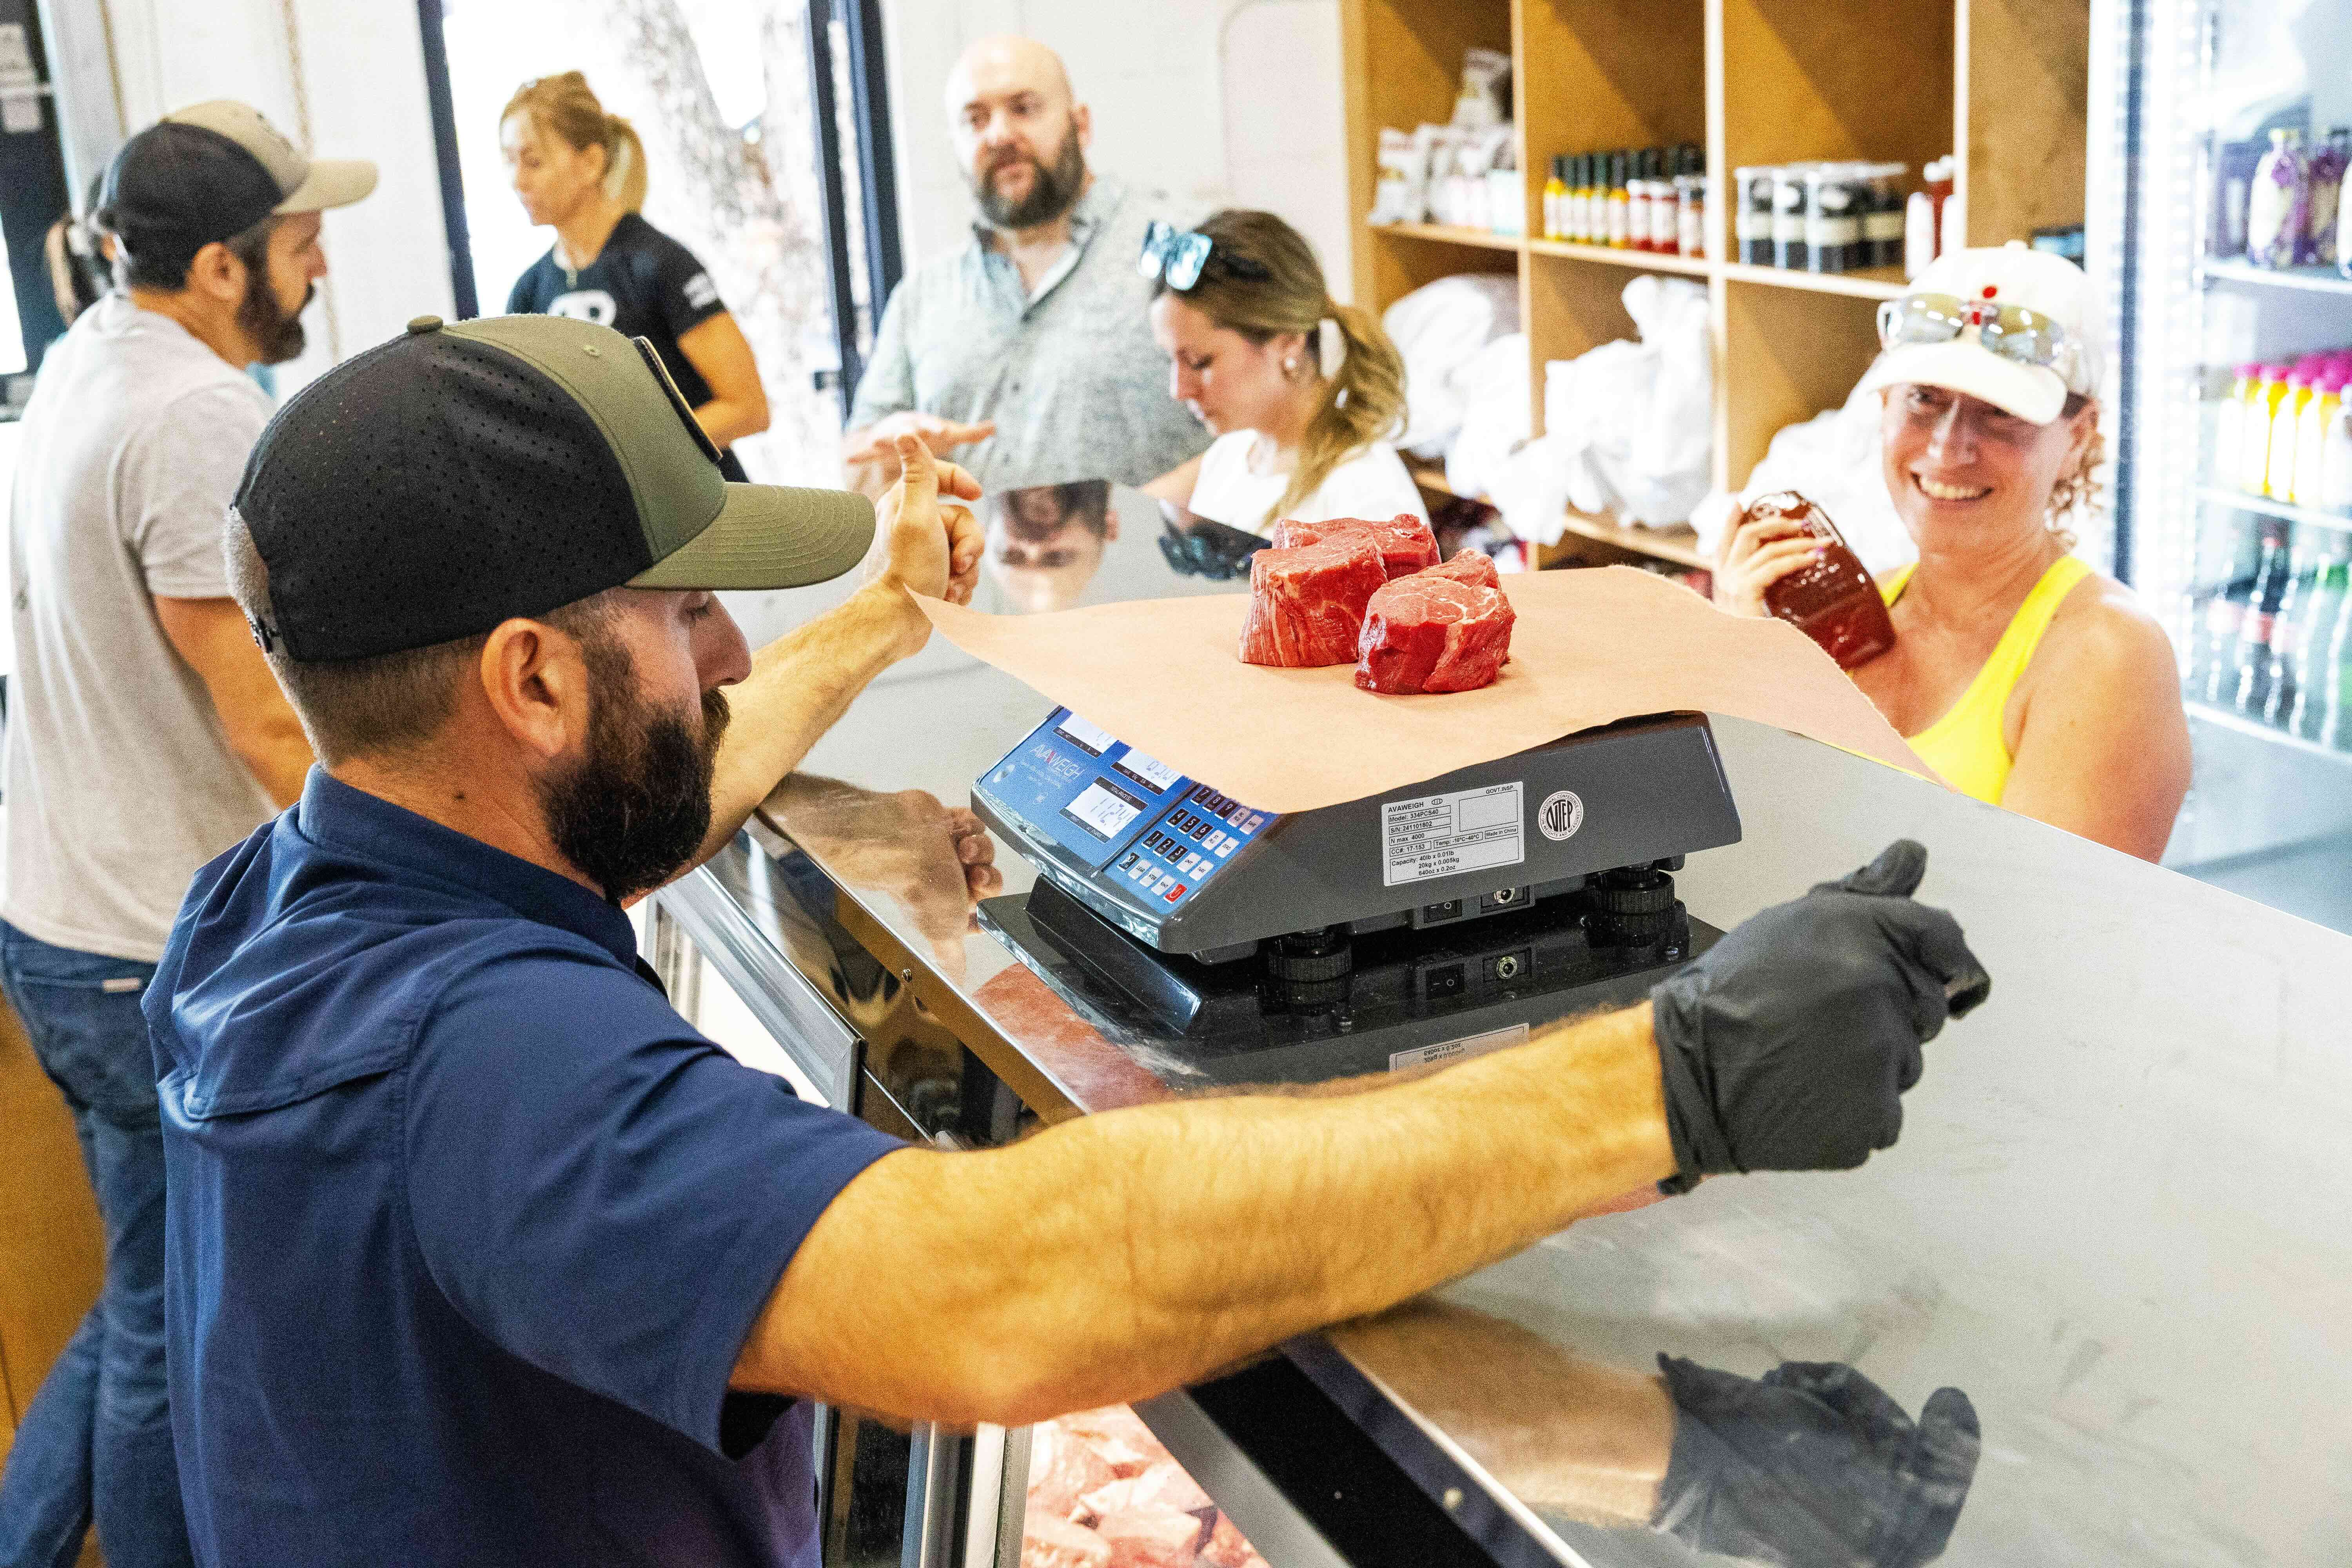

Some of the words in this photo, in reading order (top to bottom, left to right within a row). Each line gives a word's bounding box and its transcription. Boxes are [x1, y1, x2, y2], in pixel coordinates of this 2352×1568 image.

[1388, 801, 1424, 813] AVAWEIGH
[1557, 794, 1579, 808] CONFERENCE
[1410, 809, 1439, 818] 334PCS40
[1546, 799, 1573, 832] NTEP
[1543, 825, 1558, 837] WEIGHTS
[1568, 811, 1580, 833] MEASURES
[1392, 858, 1418, 866] Capacity:
